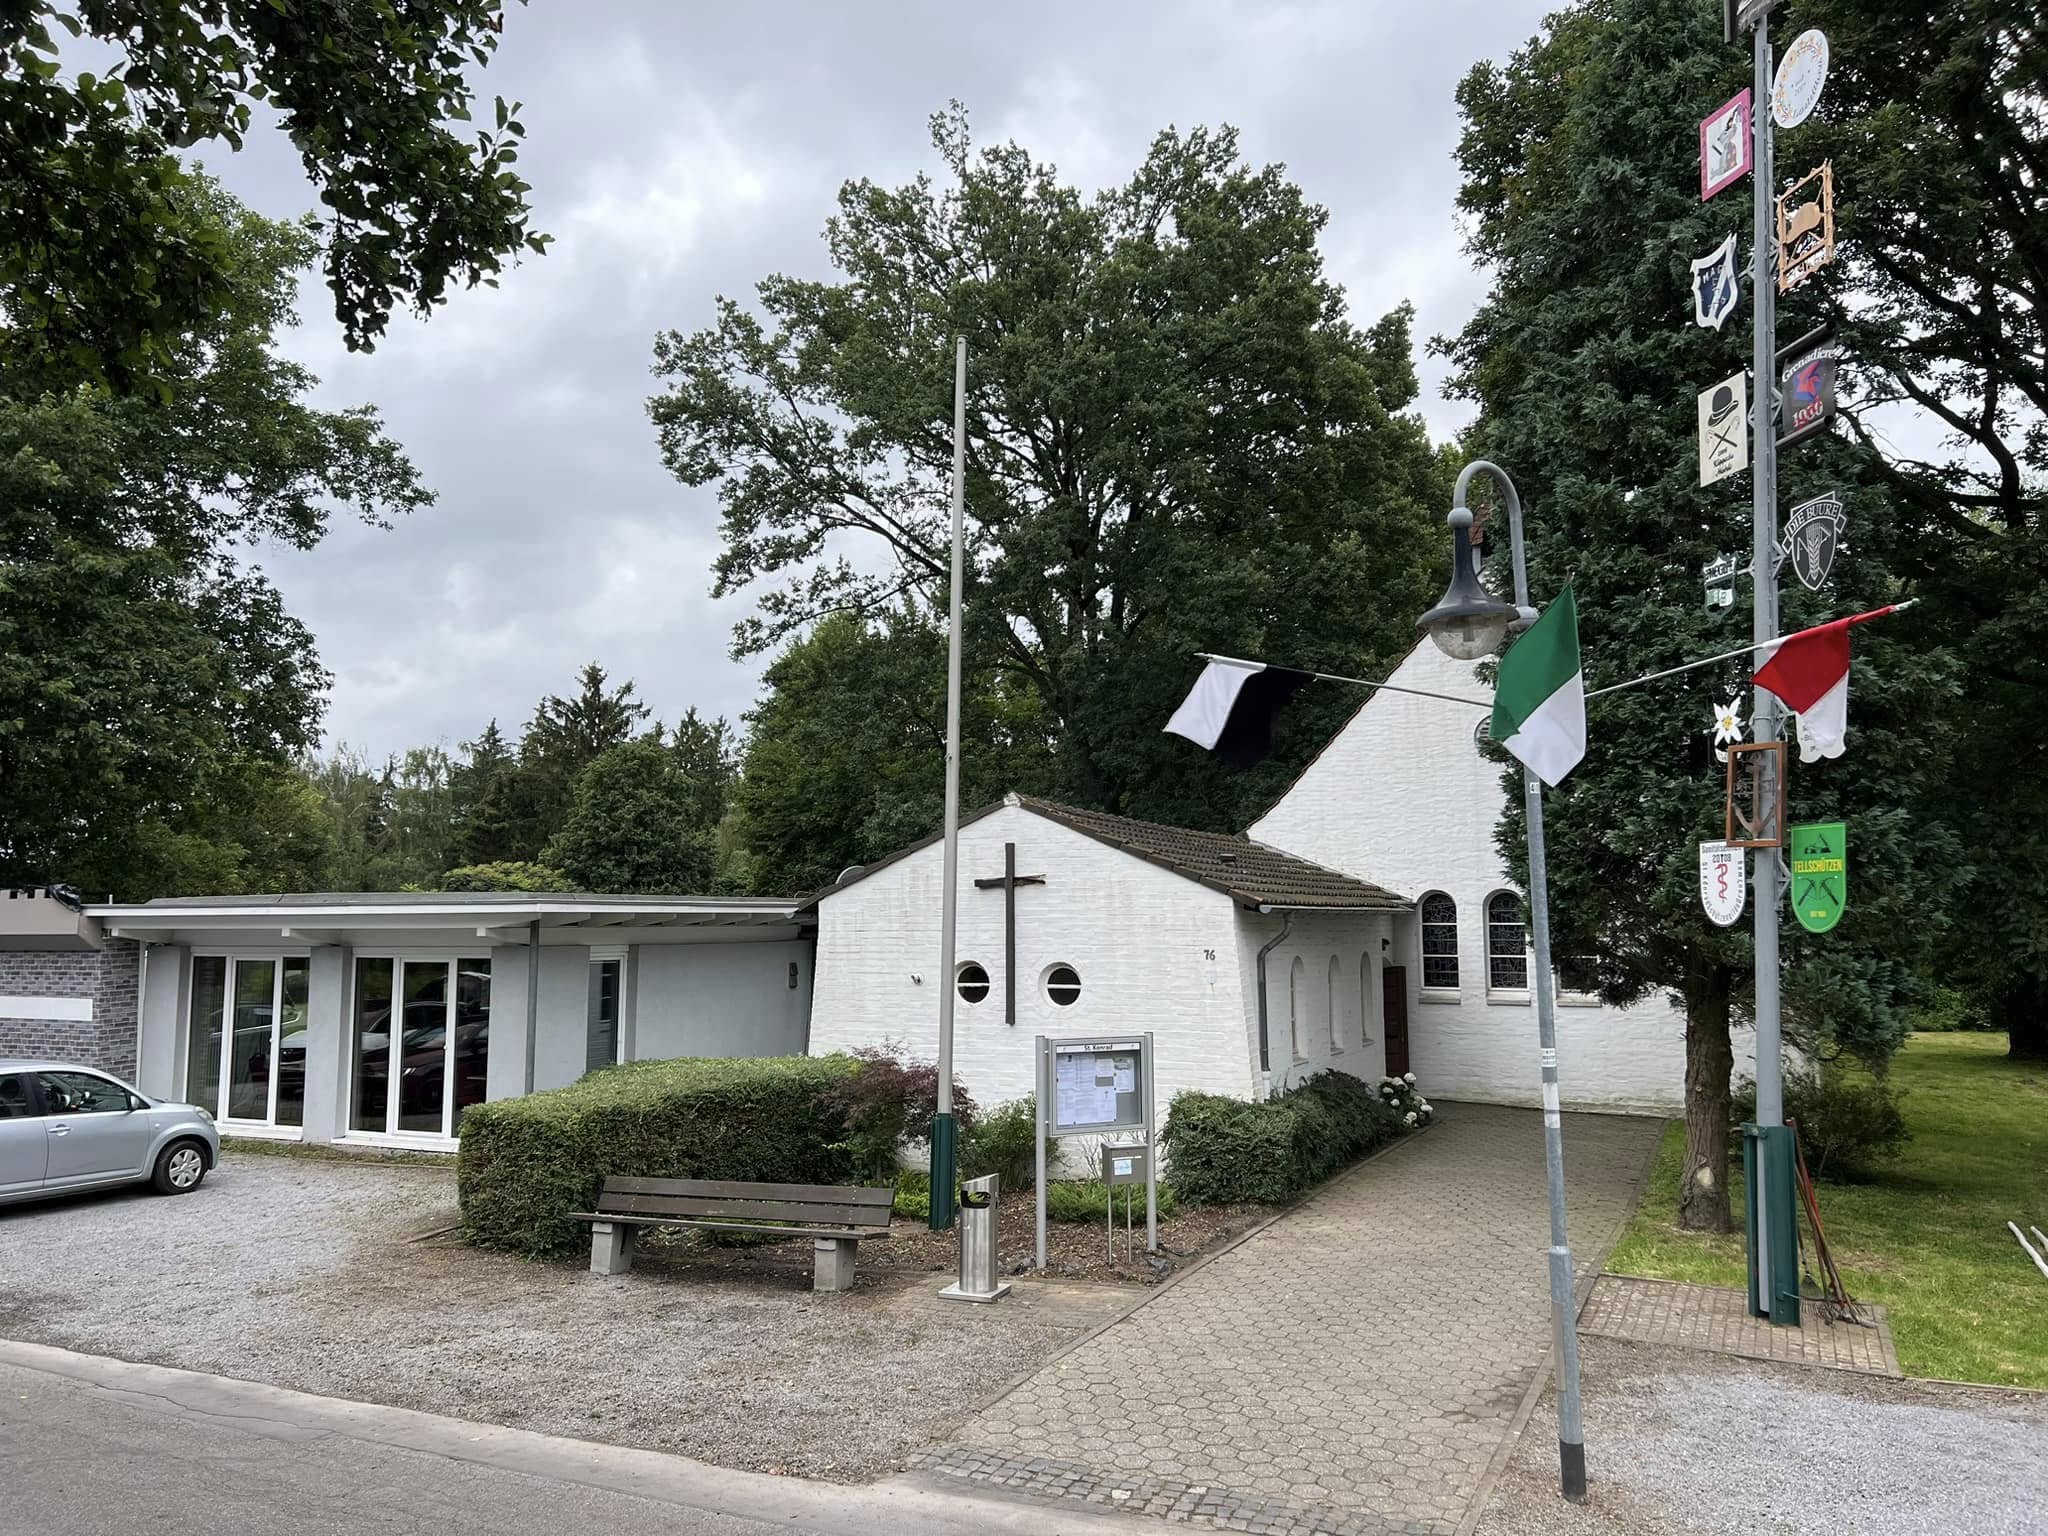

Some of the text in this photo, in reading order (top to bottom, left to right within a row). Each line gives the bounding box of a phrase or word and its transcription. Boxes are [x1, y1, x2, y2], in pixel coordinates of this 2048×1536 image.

[1788, 503, 1840, 535] DIE BUURE
[1793, 857, 1843, 873] TELLSCHÜTZEN
[1203, 949, 1216, 961] 76
[1092, 1043, 1113, 1051] Konrad
